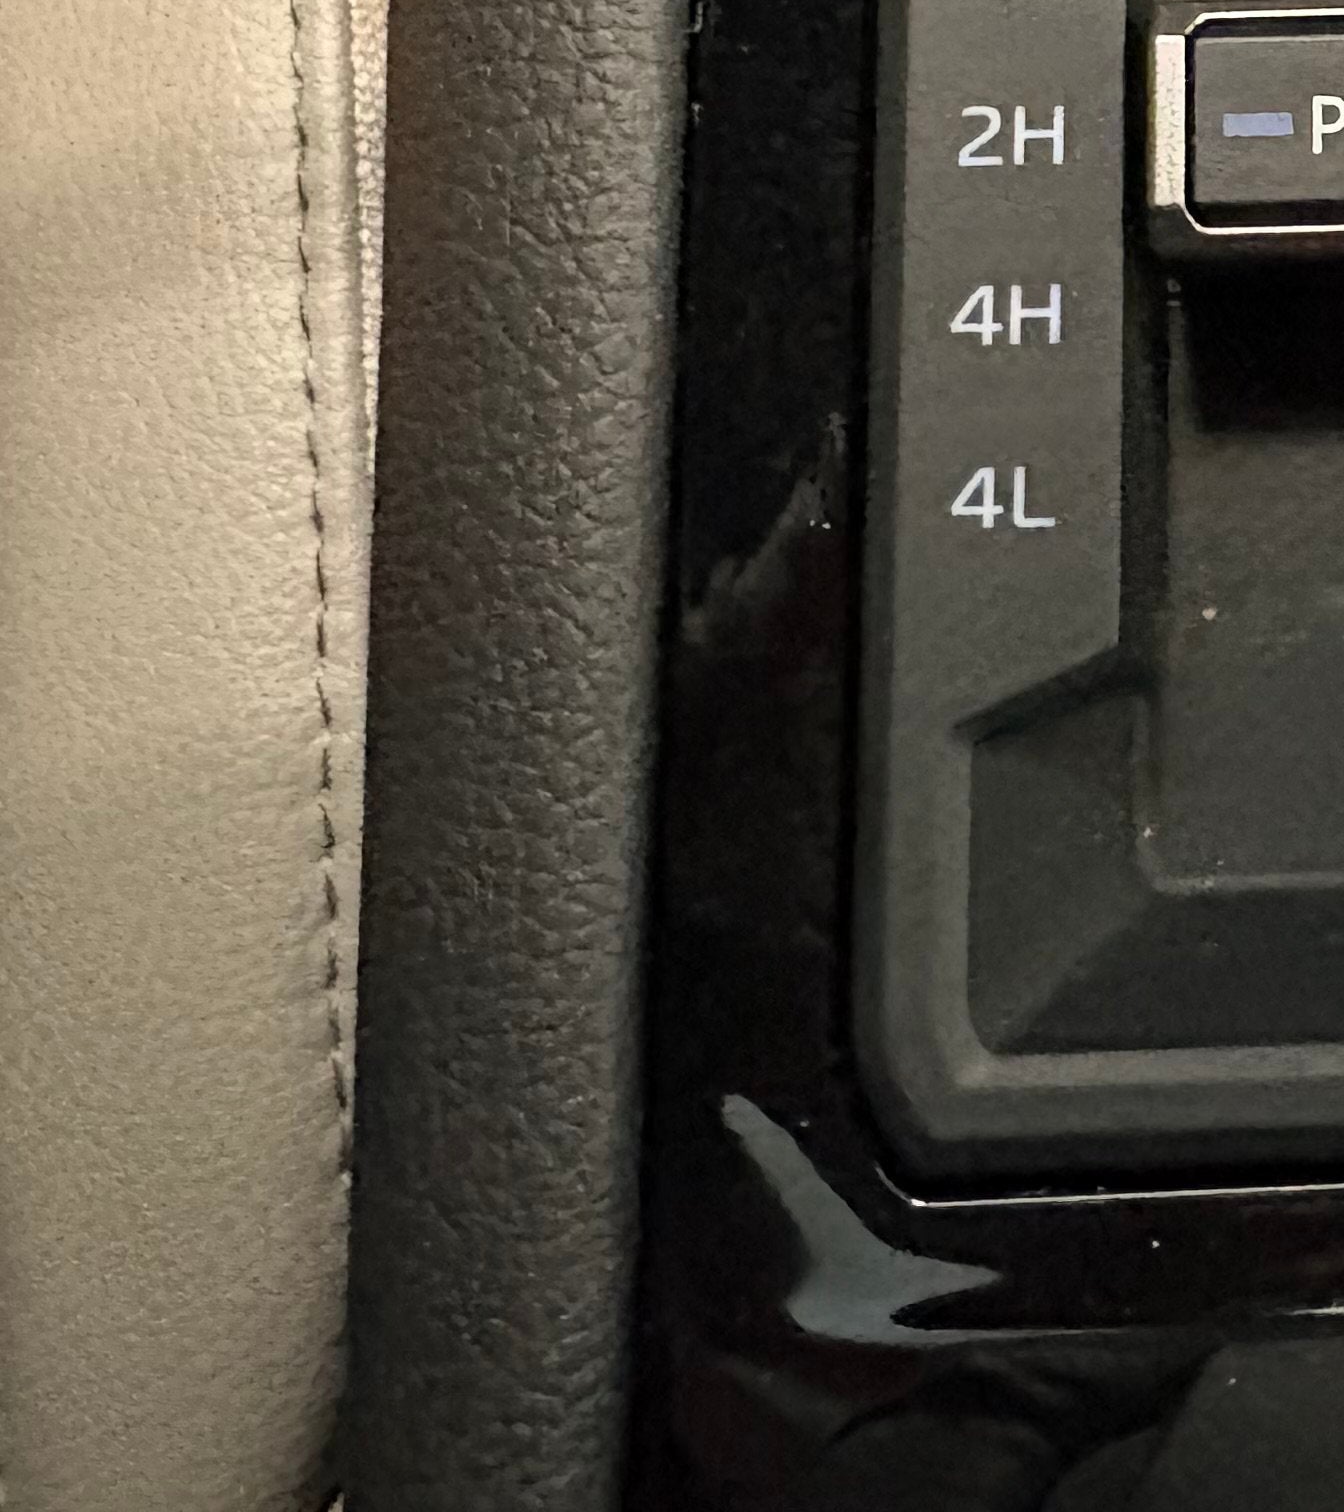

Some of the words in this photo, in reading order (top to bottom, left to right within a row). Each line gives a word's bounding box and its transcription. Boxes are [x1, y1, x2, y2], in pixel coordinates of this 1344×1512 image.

[957, 104, 1066, 168] 2H
[948, 282, 1062, 347] 4H
[949, 465, 1057, 530] 4L
